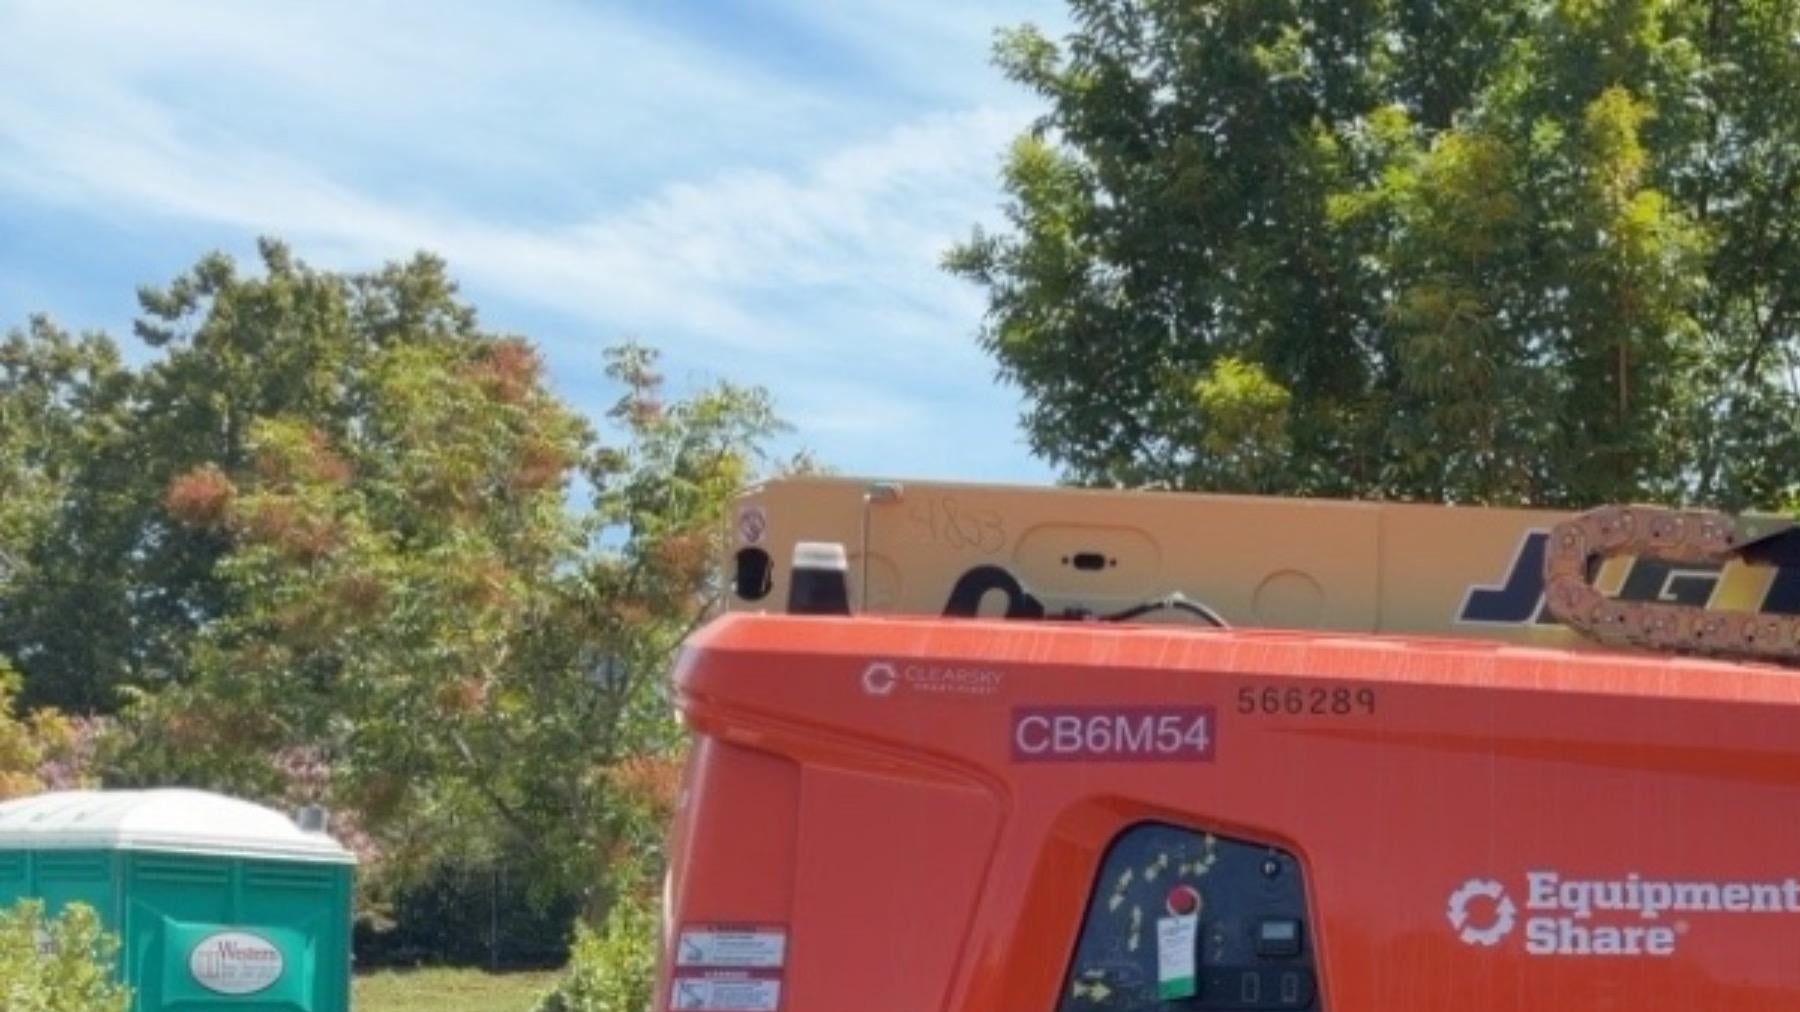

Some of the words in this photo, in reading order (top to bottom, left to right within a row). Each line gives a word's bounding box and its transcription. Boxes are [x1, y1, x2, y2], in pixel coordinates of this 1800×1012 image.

[1236, 687, 1375, 715] 566289
[1014, 715, 1210, 753] CB6M54
[217, 939, 278, 962] Western
